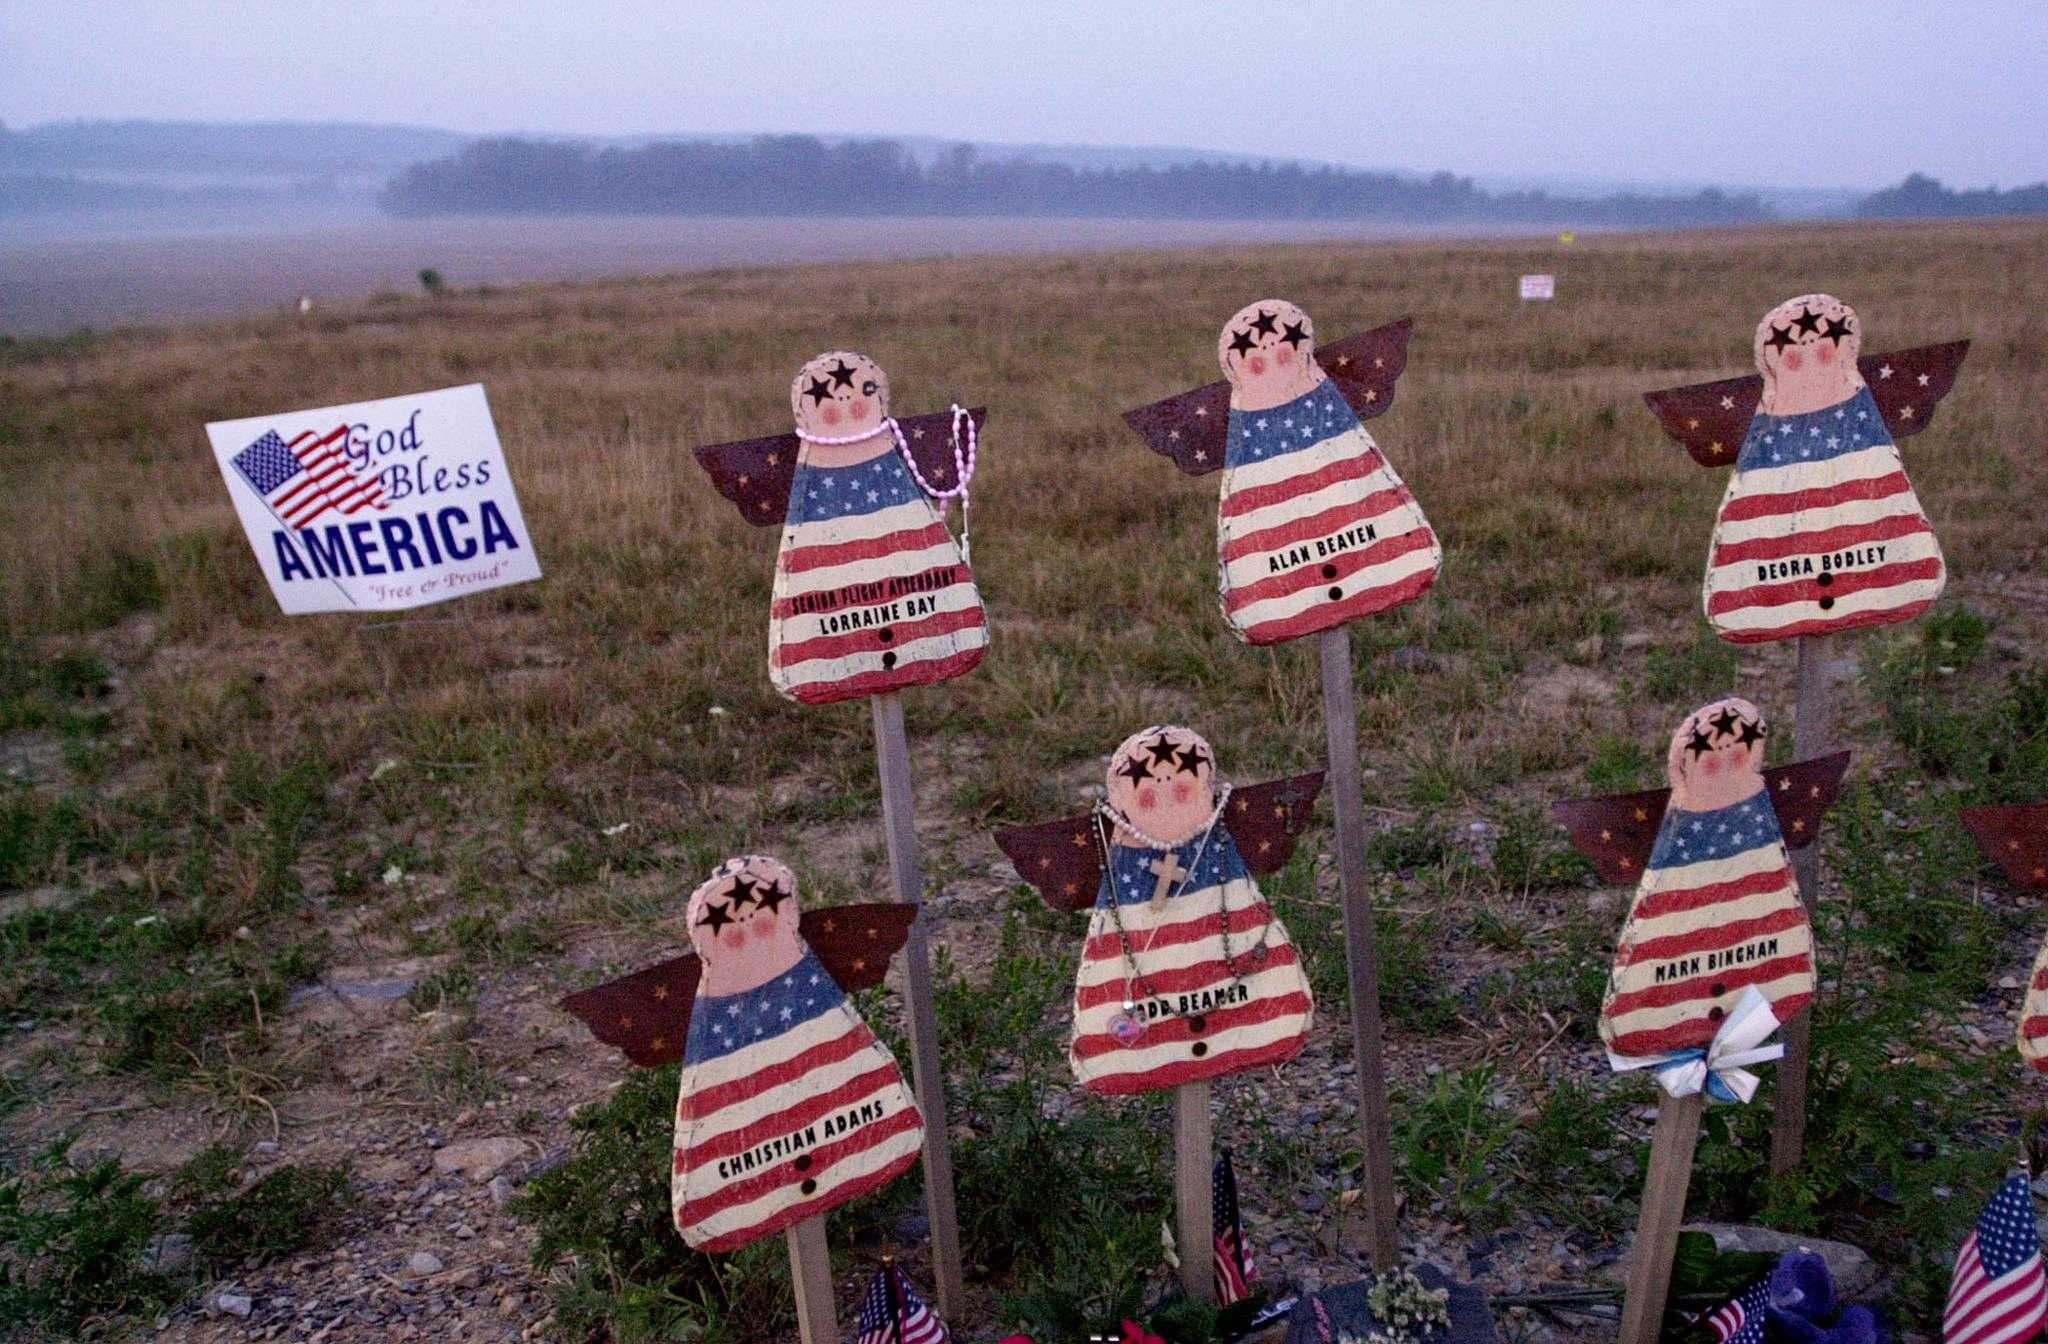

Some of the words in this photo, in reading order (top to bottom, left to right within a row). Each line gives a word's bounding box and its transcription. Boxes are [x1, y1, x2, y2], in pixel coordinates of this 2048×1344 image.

[343, 408, 423, 472] God
[379, 456, 491, 501] Bless
[272, 500, 519, 581] AMERICA
[1268, 545, 1311, 573] ALAN
[1316, 523, 1377, 557] BEAVEN
[1758, 557, 1813, 581] DEORA
[1822, 545, 1887, 570] BODLEY
[792, 591, 837, 615] SENIOR
[842, 581, 884, 605] FLIGHT
[889, 568, 957, 598] ATTENDANT
[820, 603, 900, 635] LORRAINE
[907, 595, 937, 618] BAY
[1656, 957, 1700, 983] MARK
[1708, 938, 1778, 971] BINGHAM
[1179, 984, 1249, 1013] BEAMER
[718, 1126, 817, 1180] CHRISTIAN
[824, 1100, 884, 1139] ADAMS
